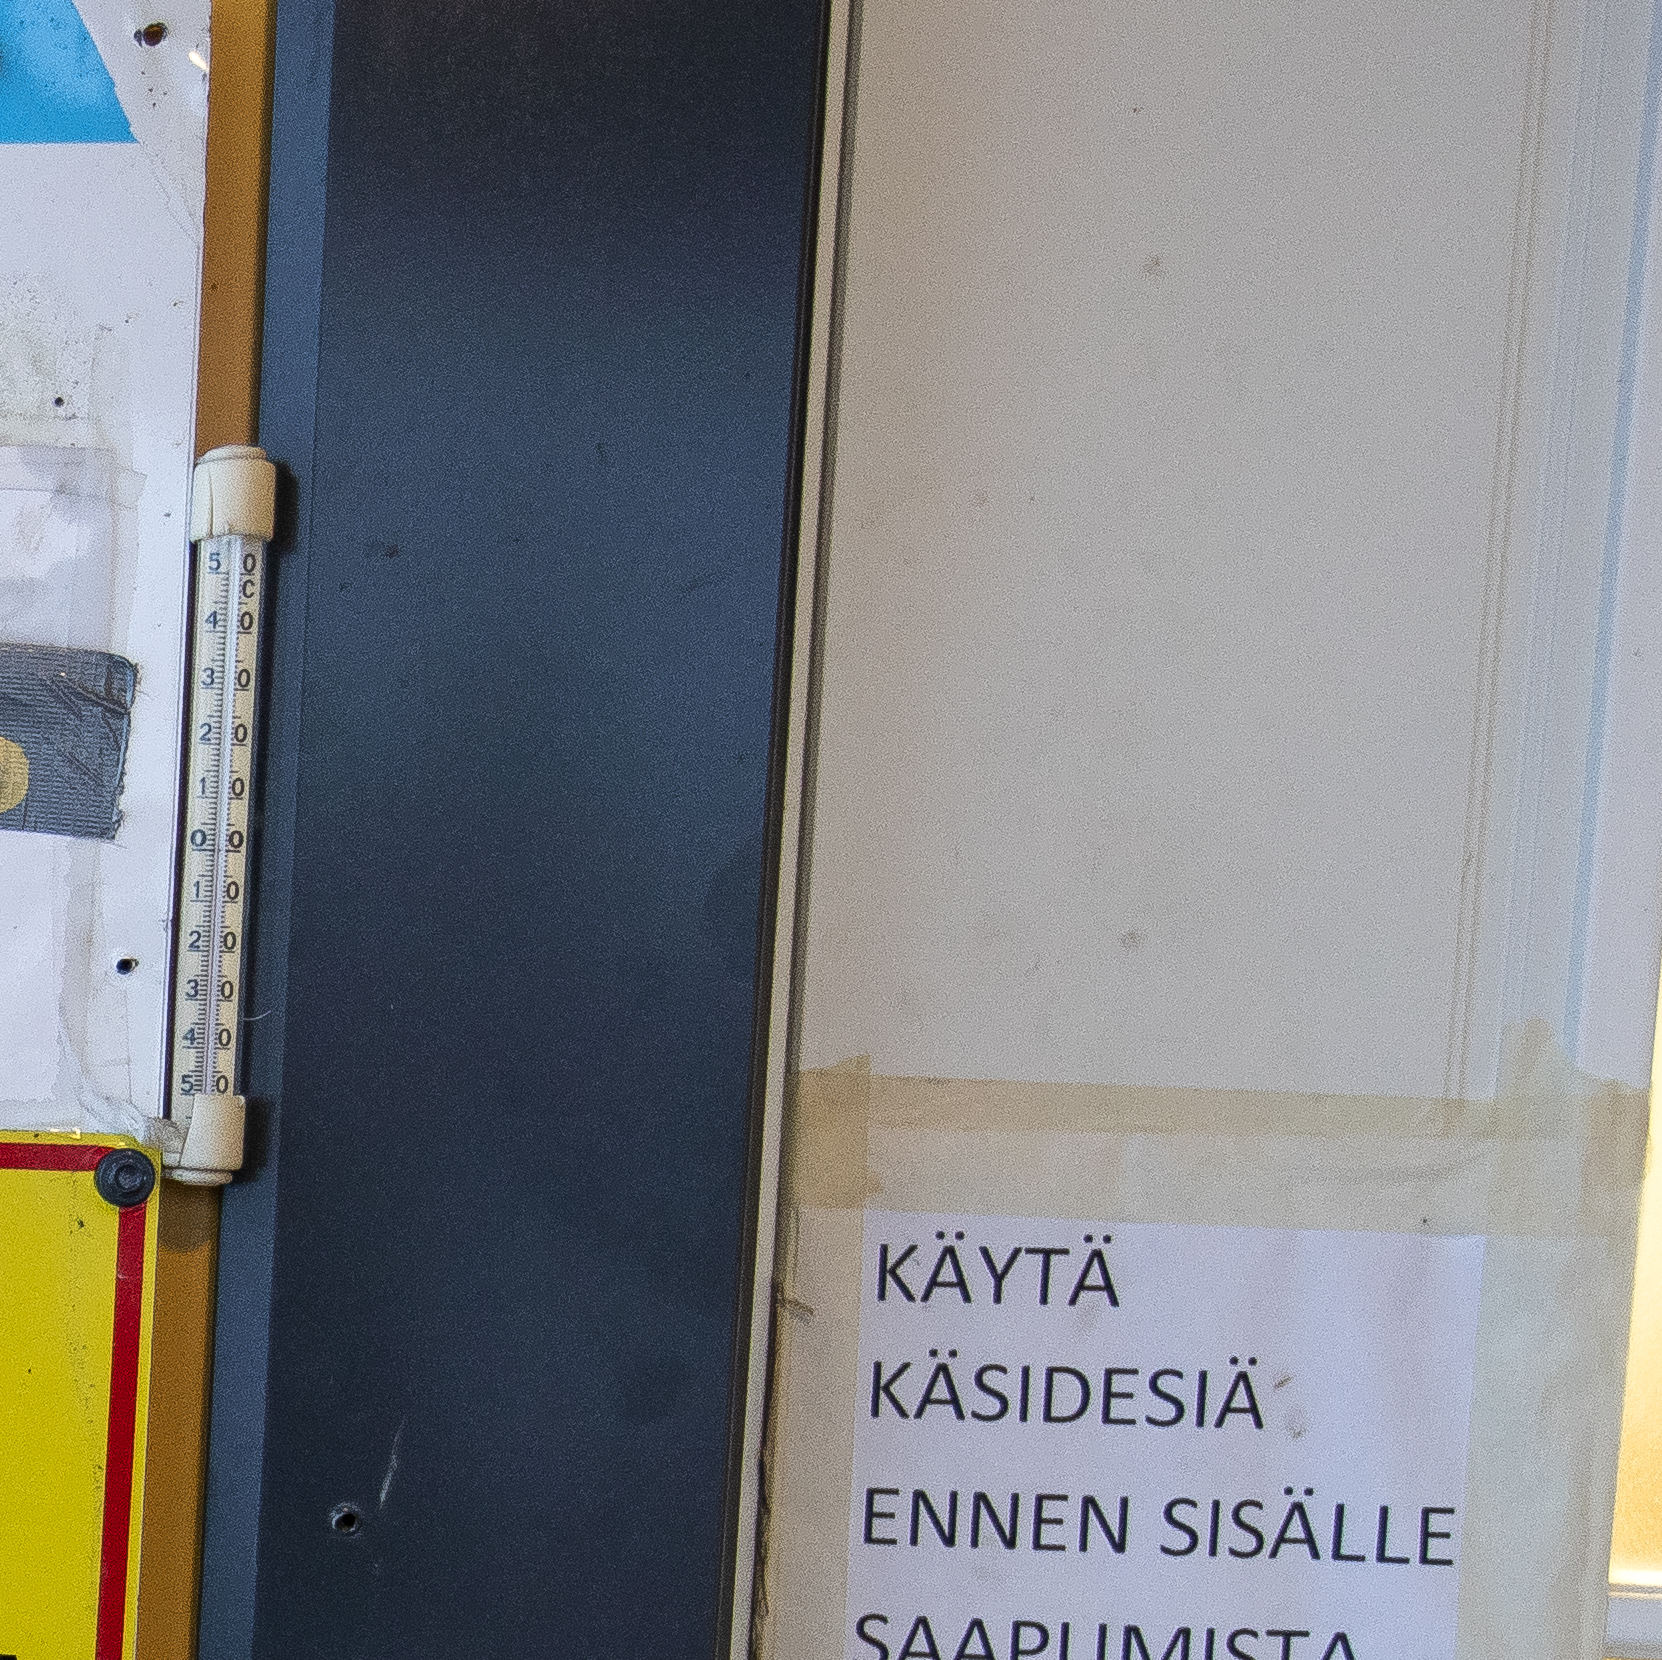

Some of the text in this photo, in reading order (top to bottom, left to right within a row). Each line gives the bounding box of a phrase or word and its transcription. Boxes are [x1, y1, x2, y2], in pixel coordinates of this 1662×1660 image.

[876, 1230, 1120, 1307] KÄYTÄ
[870, 1348, 1265, 1430] KÄSIDESIÄ
[863, 1486, 1456, 1566] ENNEN SISÄLLE
